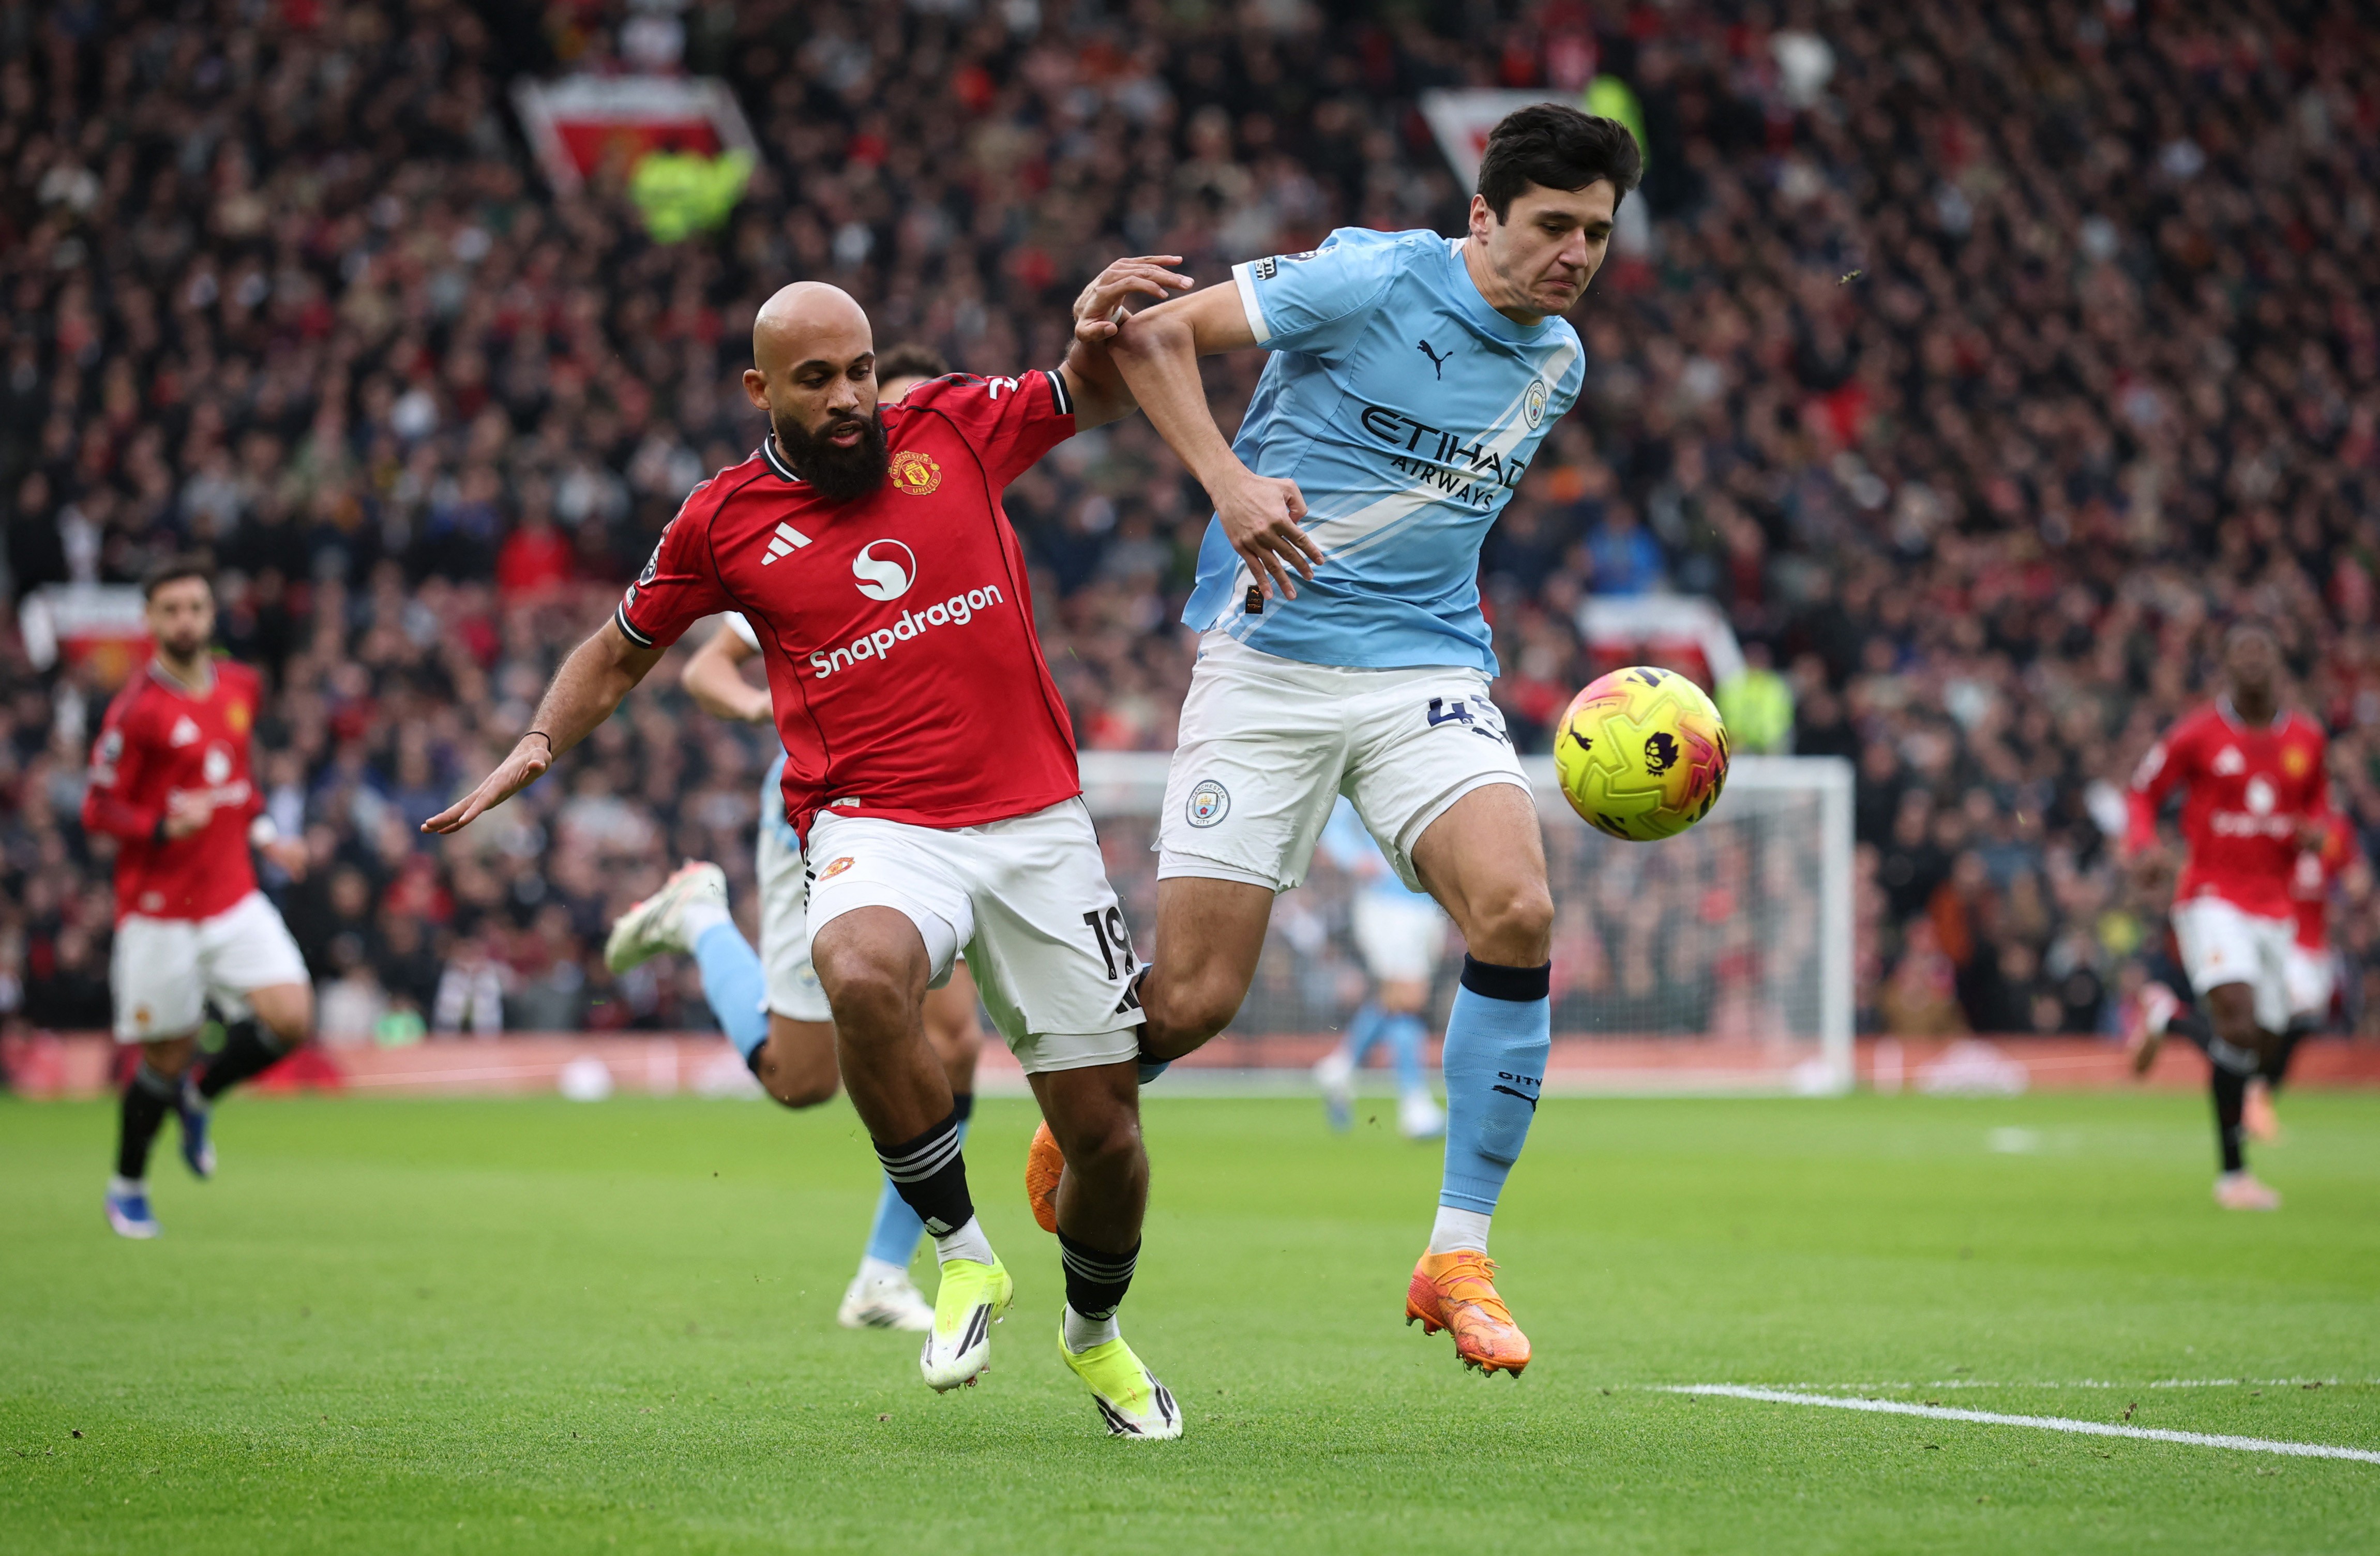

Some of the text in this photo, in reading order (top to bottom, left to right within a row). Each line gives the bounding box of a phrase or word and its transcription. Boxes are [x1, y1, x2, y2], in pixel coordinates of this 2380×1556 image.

[893, 454, 929, 475] MANCHESTER
[1361, 406, 1526, 489] ETIHAD
[912, 478, 938, 493] UNITED
[1390, 456, 1494, 512] AIRWAYS
[809, 584, 1004, 679] Snapdragon
[1191, 783, 1226, 800] MANCHESTER
[1083, 906, 1136, 980] 19
